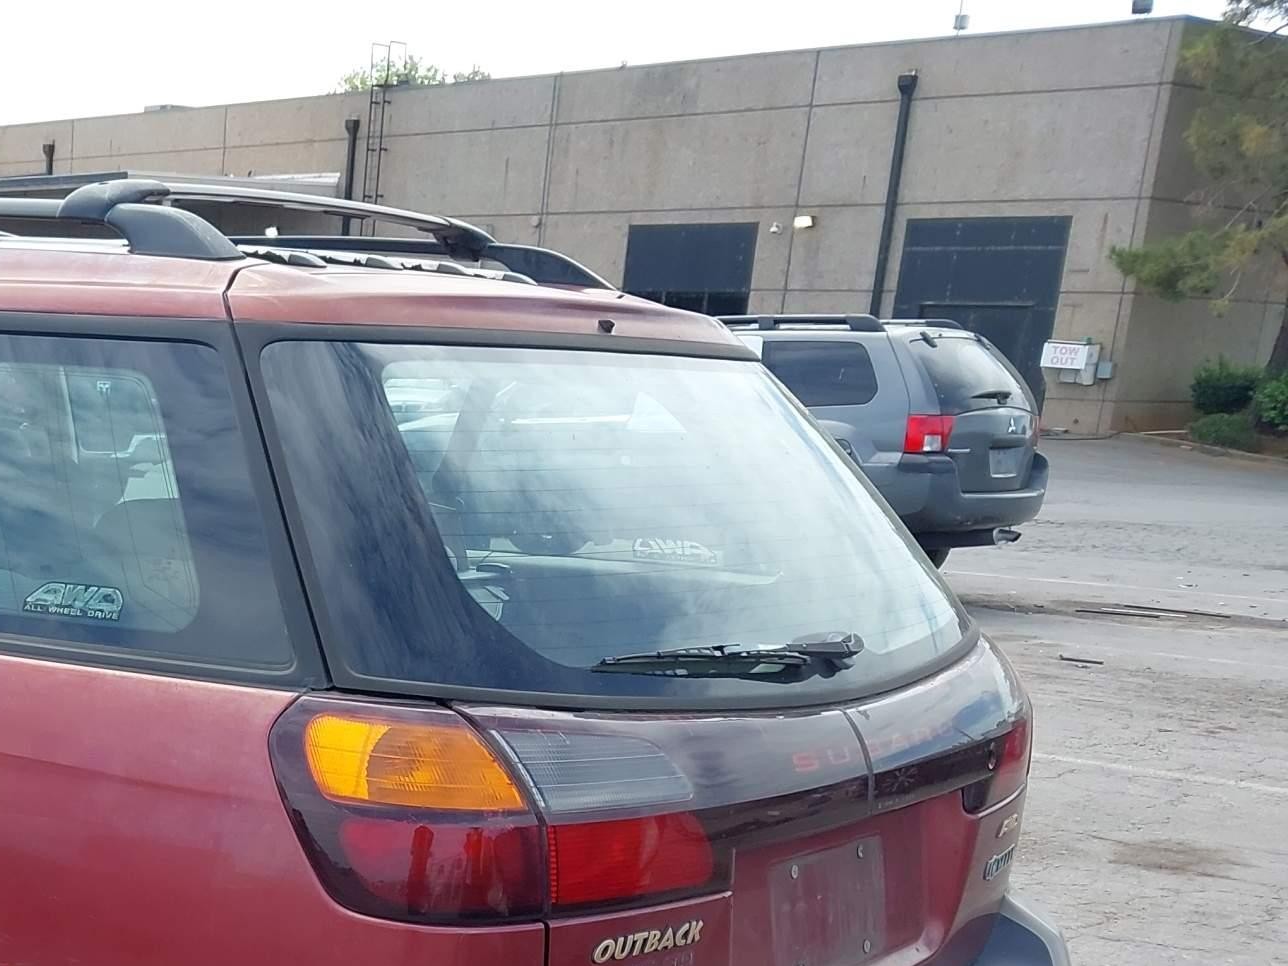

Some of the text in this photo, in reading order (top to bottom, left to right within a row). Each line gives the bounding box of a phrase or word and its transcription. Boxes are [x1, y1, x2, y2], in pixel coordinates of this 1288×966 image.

[1052, 345, 1080, 357] TOW
[1050, 356, 1077, 366] OUT
[25, 583, 123, 609] AWD
[23, 603, 119, 620] ALL WHEEL DRIVE
[593, 919, 704, 964] OUTBACK
